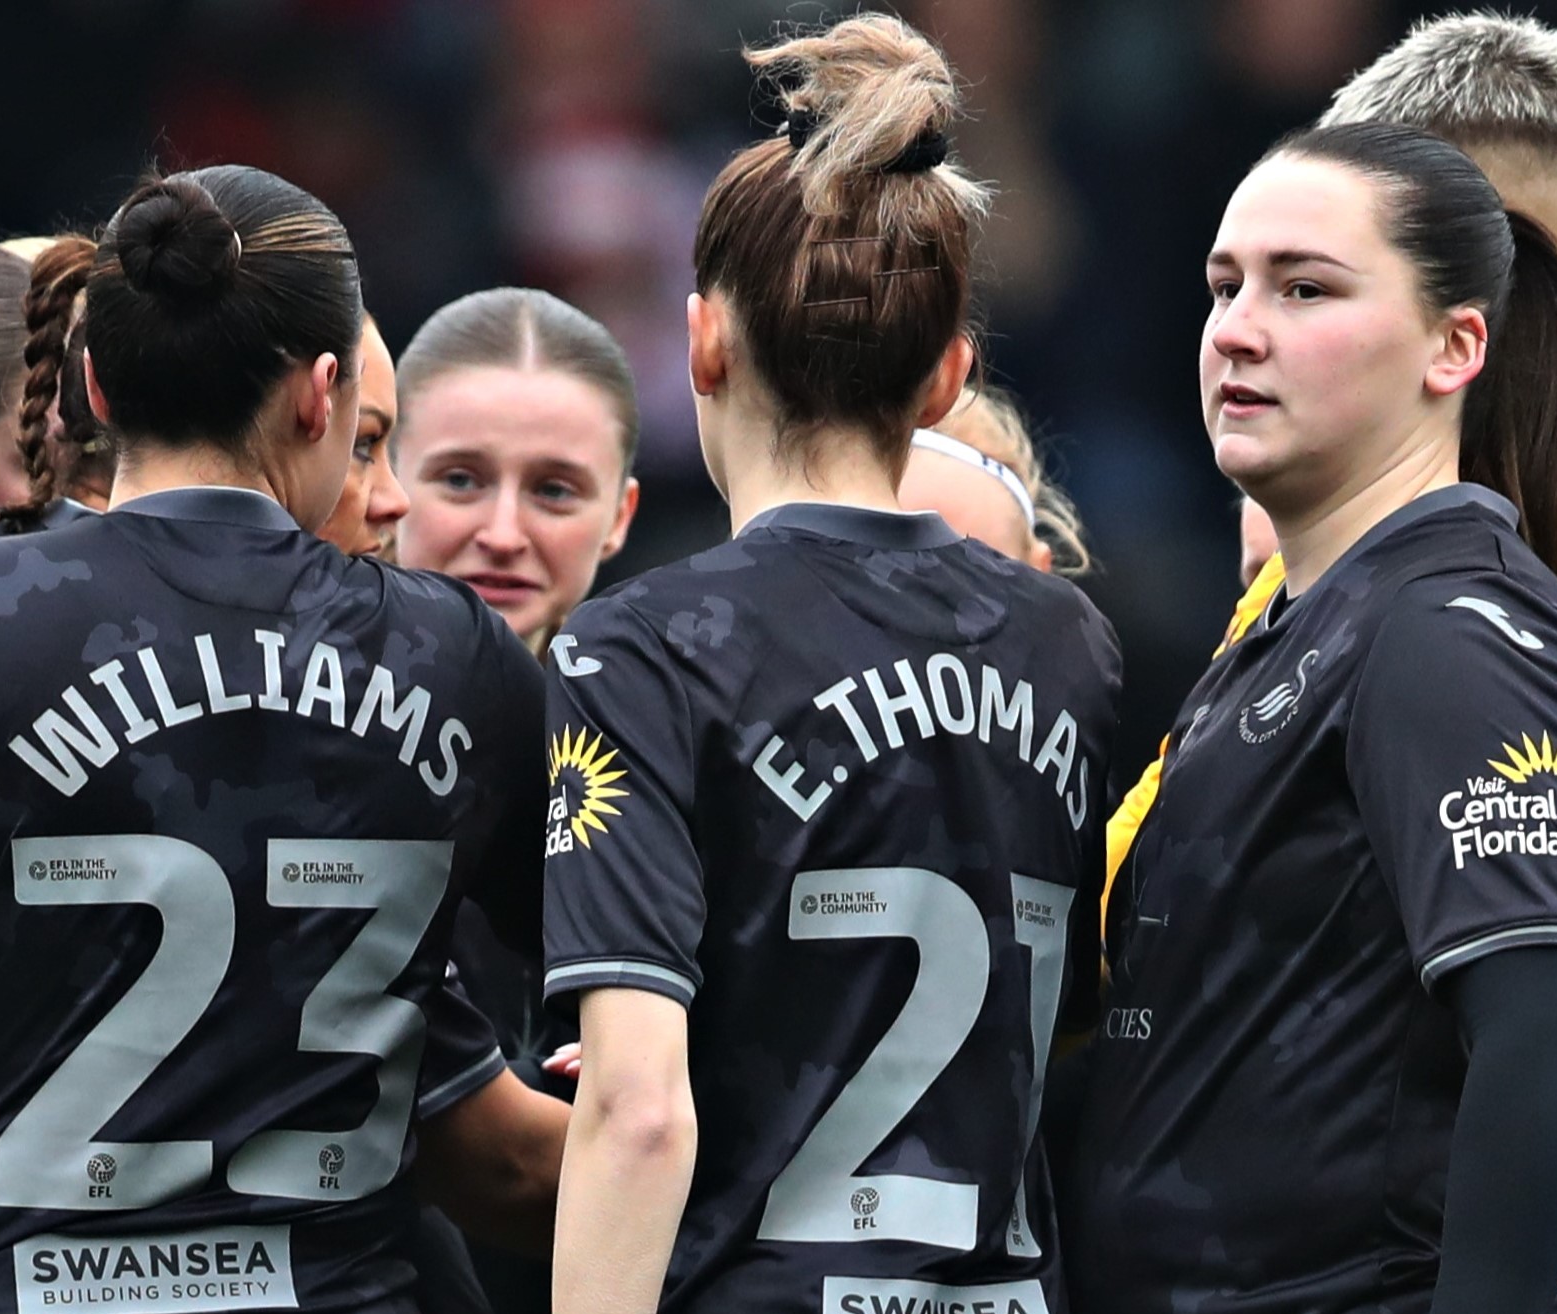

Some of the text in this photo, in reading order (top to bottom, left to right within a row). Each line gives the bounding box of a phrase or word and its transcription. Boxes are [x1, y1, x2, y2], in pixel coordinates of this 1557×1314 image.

[9, 629, 473, 797] WILLIAMS
[751, 652, 1091, 832] E.THOMAS
[1466, 775, 1507, 797] Visit
[1439, 788, 1557, 830] Central
[49, 858, 106, 870] EFL IN THE
[303, 862, 355, 873] EFL IN THE
[50, 869, 117, 881] COMMUNITY
[303, 873, 364, 885] COMMUNITY
[820, 891, 876, 904] EFL IN THE
[820, 902, 887, 914] COMMUNITY
[1106, 1007, 1153, 1040] CIES
[756, 867, 1076, 1258] 21
[319, 1176, 340, 1190] EFL
[87, 1185, 113, 1199] EFL
[852, 1217, 878, 1230] EFL
[31, 1240, 276, 1283] SWANSEA
[42, 1278, 271, 1306] BUILDING SOCIETY
